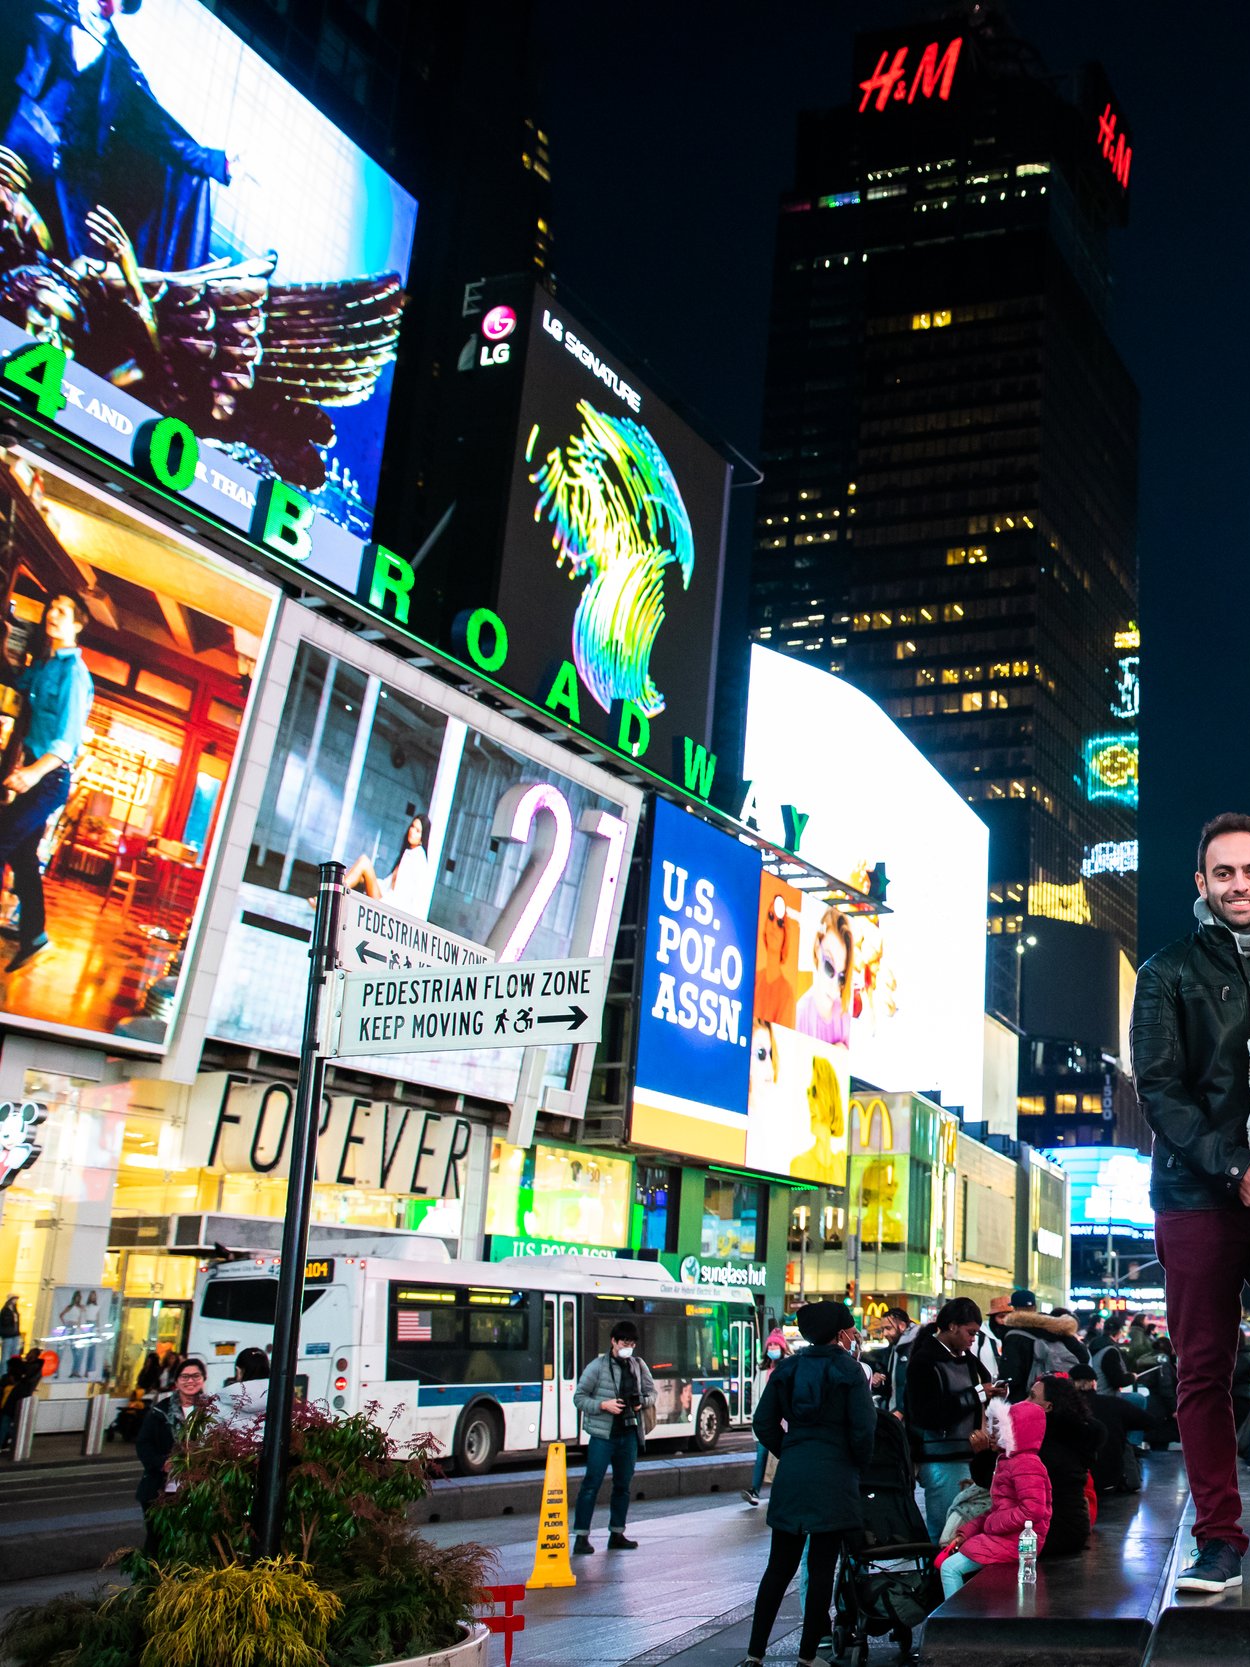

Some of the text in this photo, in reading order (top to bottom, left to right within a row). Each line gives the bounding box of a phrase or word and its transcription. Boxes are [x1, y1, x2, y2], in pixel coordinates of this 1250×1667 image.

[858, 36, 963, 113] H&M
[1098, 103, 1132, 189] H&M
[480, 343, 510, 367] LG
[542, 309, 641, 413] LG SIGNATURE
[662, 860, 721, 931] U.S.
[357, 905, 488, 966] PEDESTRIAN FLOW ZO
[656, 915, 743, 981] POLO
[362, 969, 591, 1007] PEDESTRIAN FLOW ZONE
[652, 972, 747, 1047] ASSN.
[359, 1011, 484, 1042] KEEP MOVING
[305, 1262, 329, 1278] 104
[701, 1261, 767, 1287] sunglass hut
[541, 1542, 565, 1550] MOJADO
[544, 1520, 563, 1528] FLOOR
